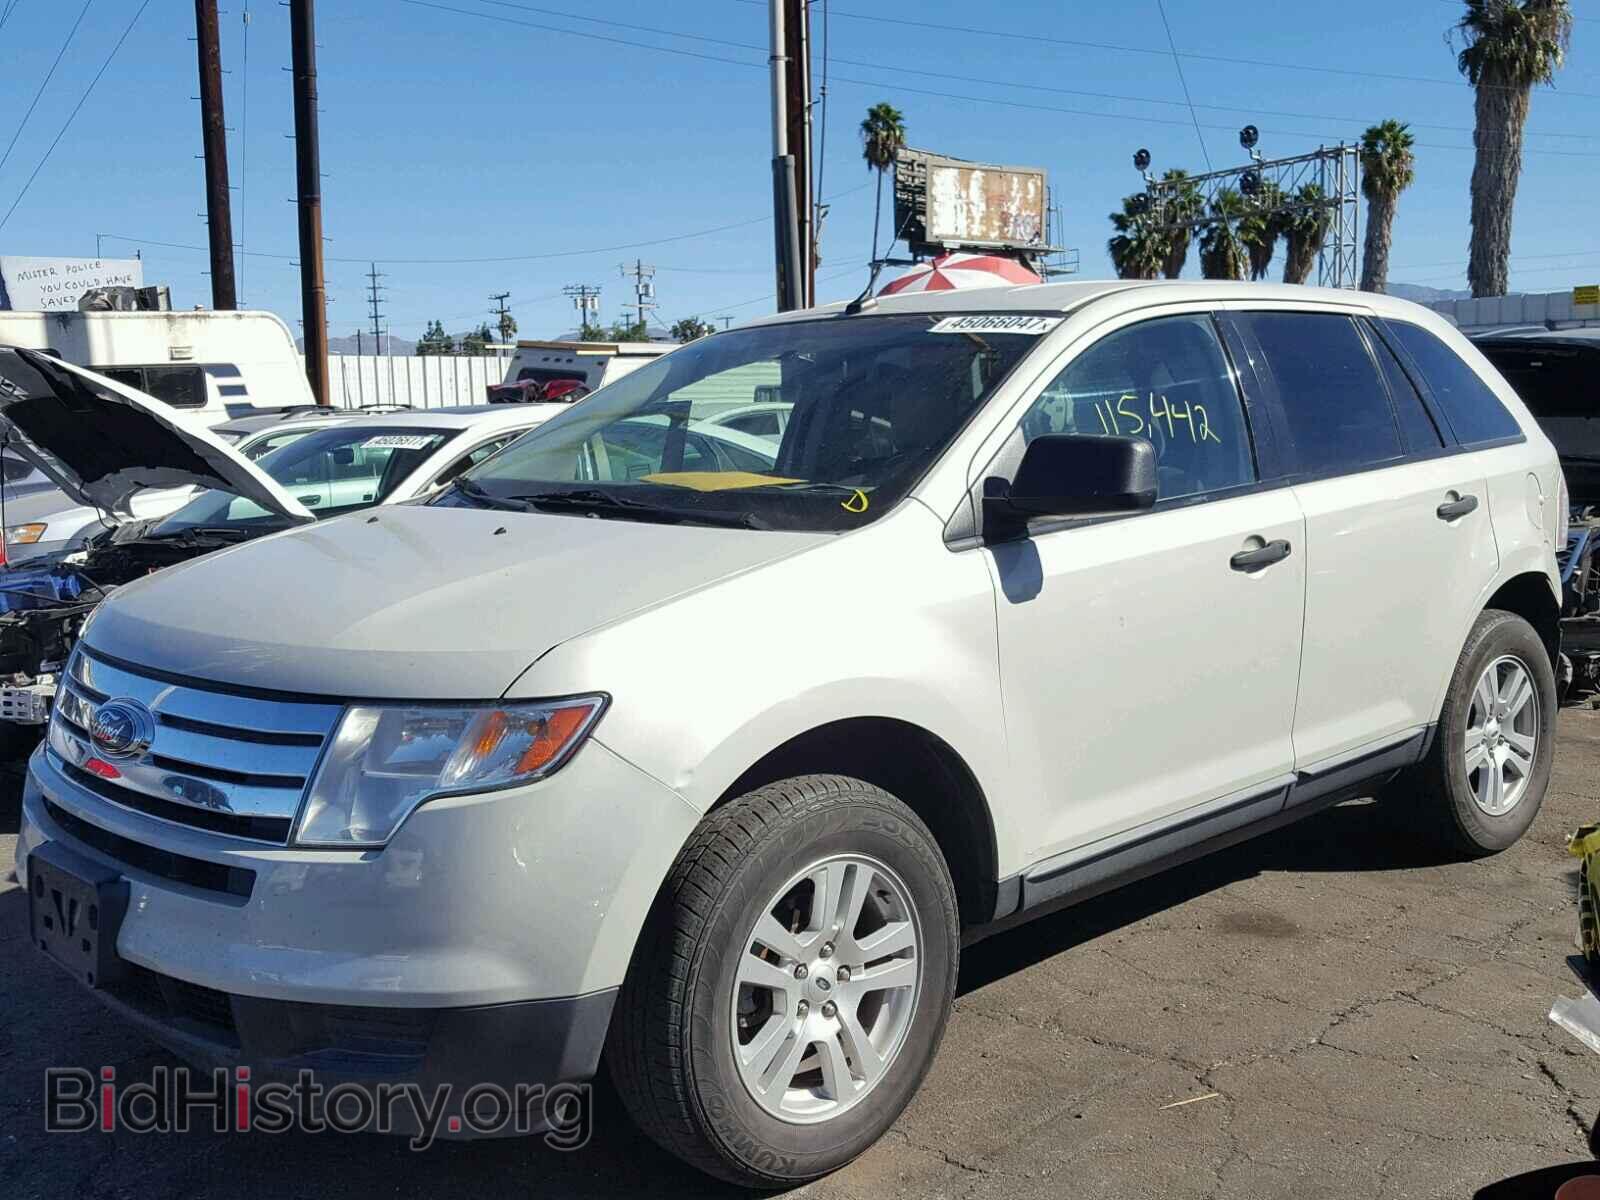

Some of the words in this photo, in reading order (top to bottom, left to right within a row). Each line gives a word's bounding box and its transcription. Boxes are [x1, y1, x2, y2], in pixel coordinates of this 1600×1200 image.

[17, 266, 58, 282] MISTER
[65, 260, 101, 275] POLICE
[40, 283, 61, 293] YOU
[64, 279, 101, 290] COULD
[106, 274, 133, 286] HAVE
[40, 295, 77, 309] SAVED
[1094, 391, 1222, 444] 115,442
